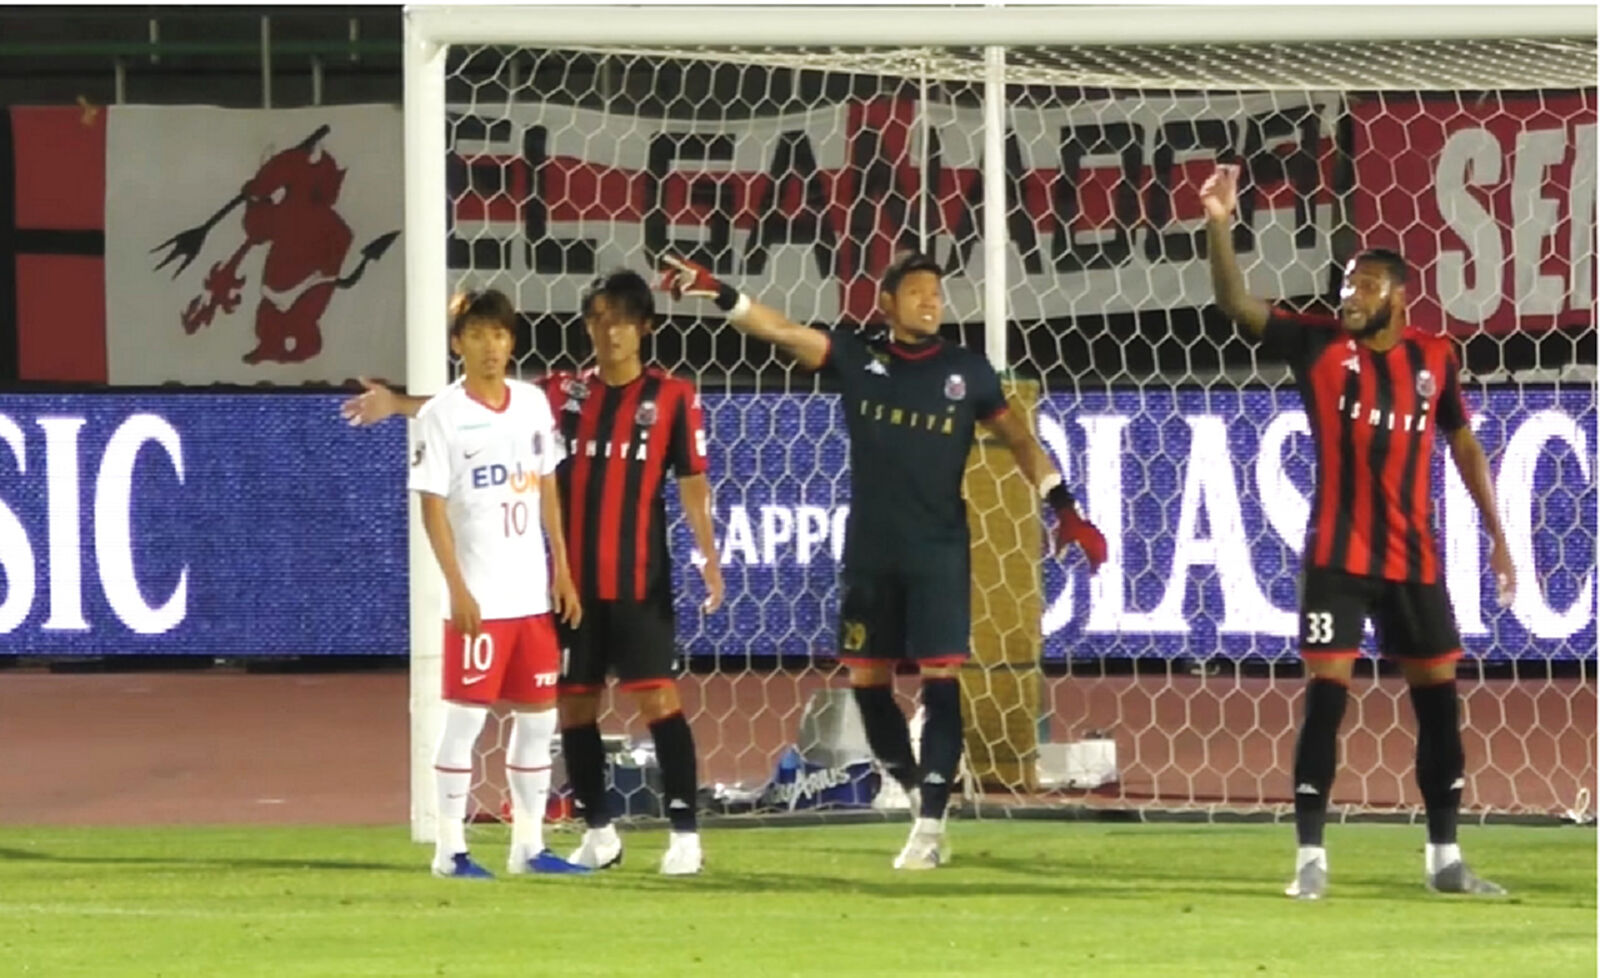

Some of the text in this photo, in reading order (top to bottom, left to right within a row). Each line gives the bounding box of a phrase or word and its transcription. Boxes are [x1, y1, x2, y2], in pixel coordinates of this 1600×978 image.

[501, 501, 528, 538] 10
[690, 502, 851, 566] APP
[1037, 408, 1595, 638] LASIC
[1305, 612, 1335, 643] 33
[463, 633, 494, 671] 10
